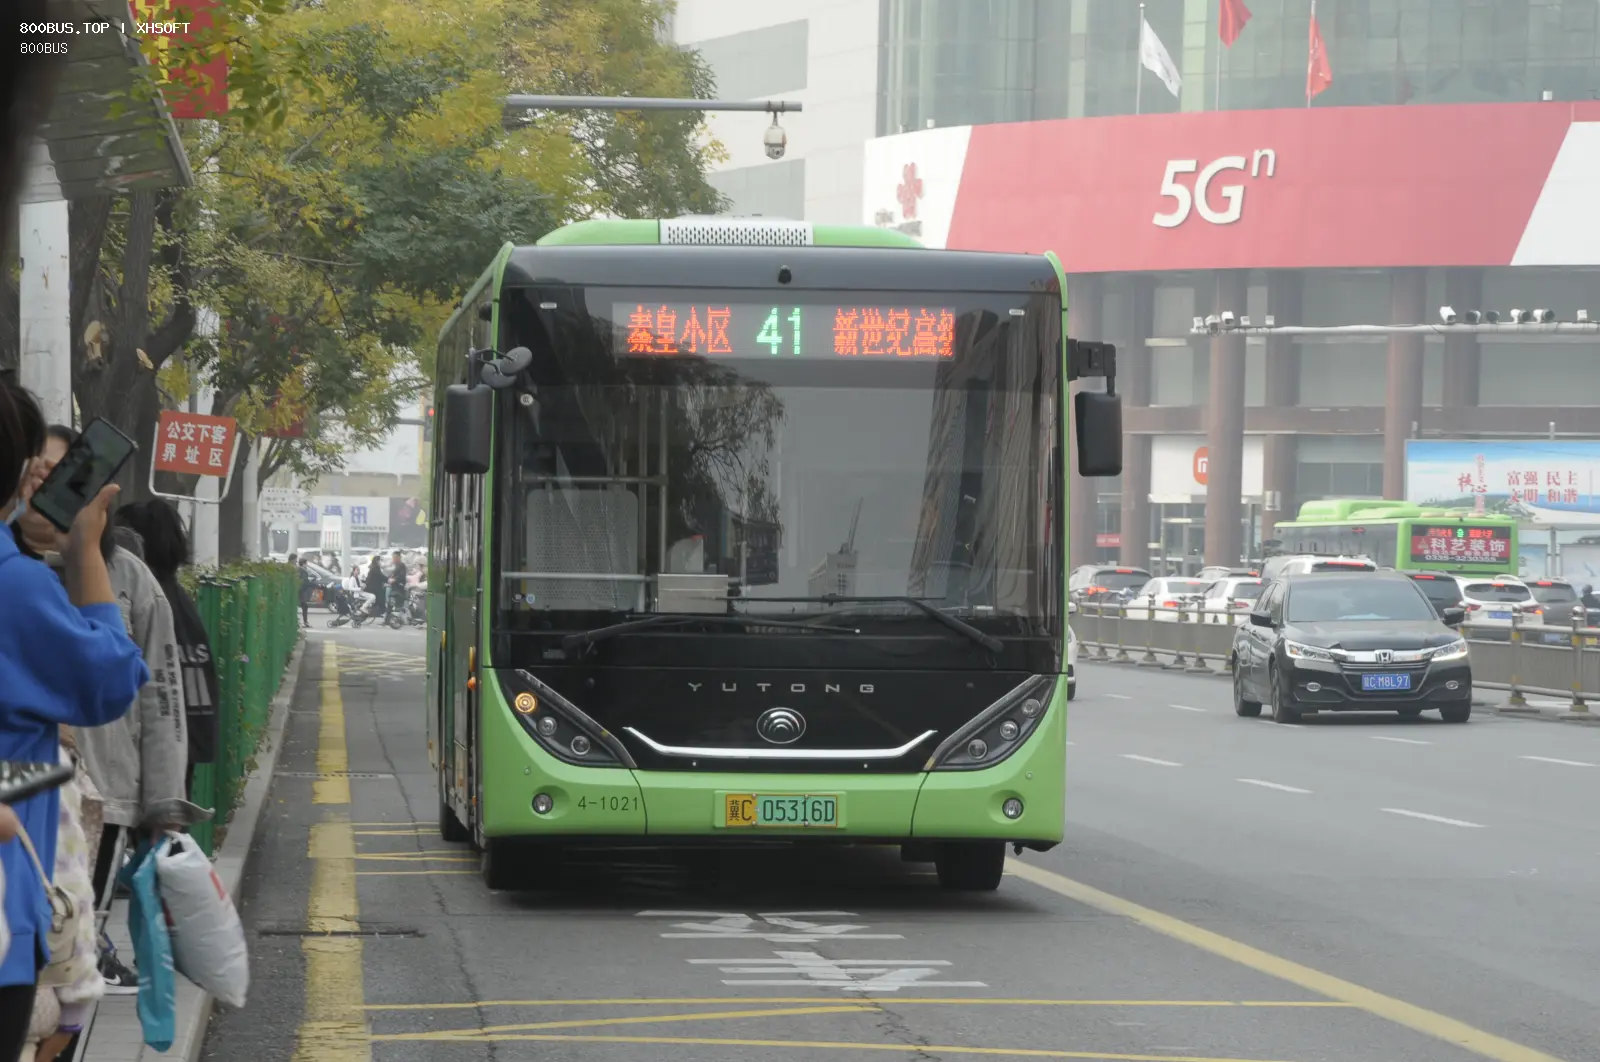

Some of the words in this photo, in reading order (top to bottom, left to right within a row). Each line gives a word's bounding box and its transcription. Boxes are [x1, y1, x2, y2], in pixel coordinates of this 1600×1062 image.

[627, 304, 732, 353] 秦皇小区
[756, 305, 801, 355] 41
[166, 420, 227, 445] 公交下客
[1507, 470, 1538, 486] 富强
[1547, 470, 1578, 486] 民主
[1431, 538, 1505, 553] 科艺装饰
[687, 681, 876, 694] YUTONG
[577, 796, 640, 813] 4-1021
